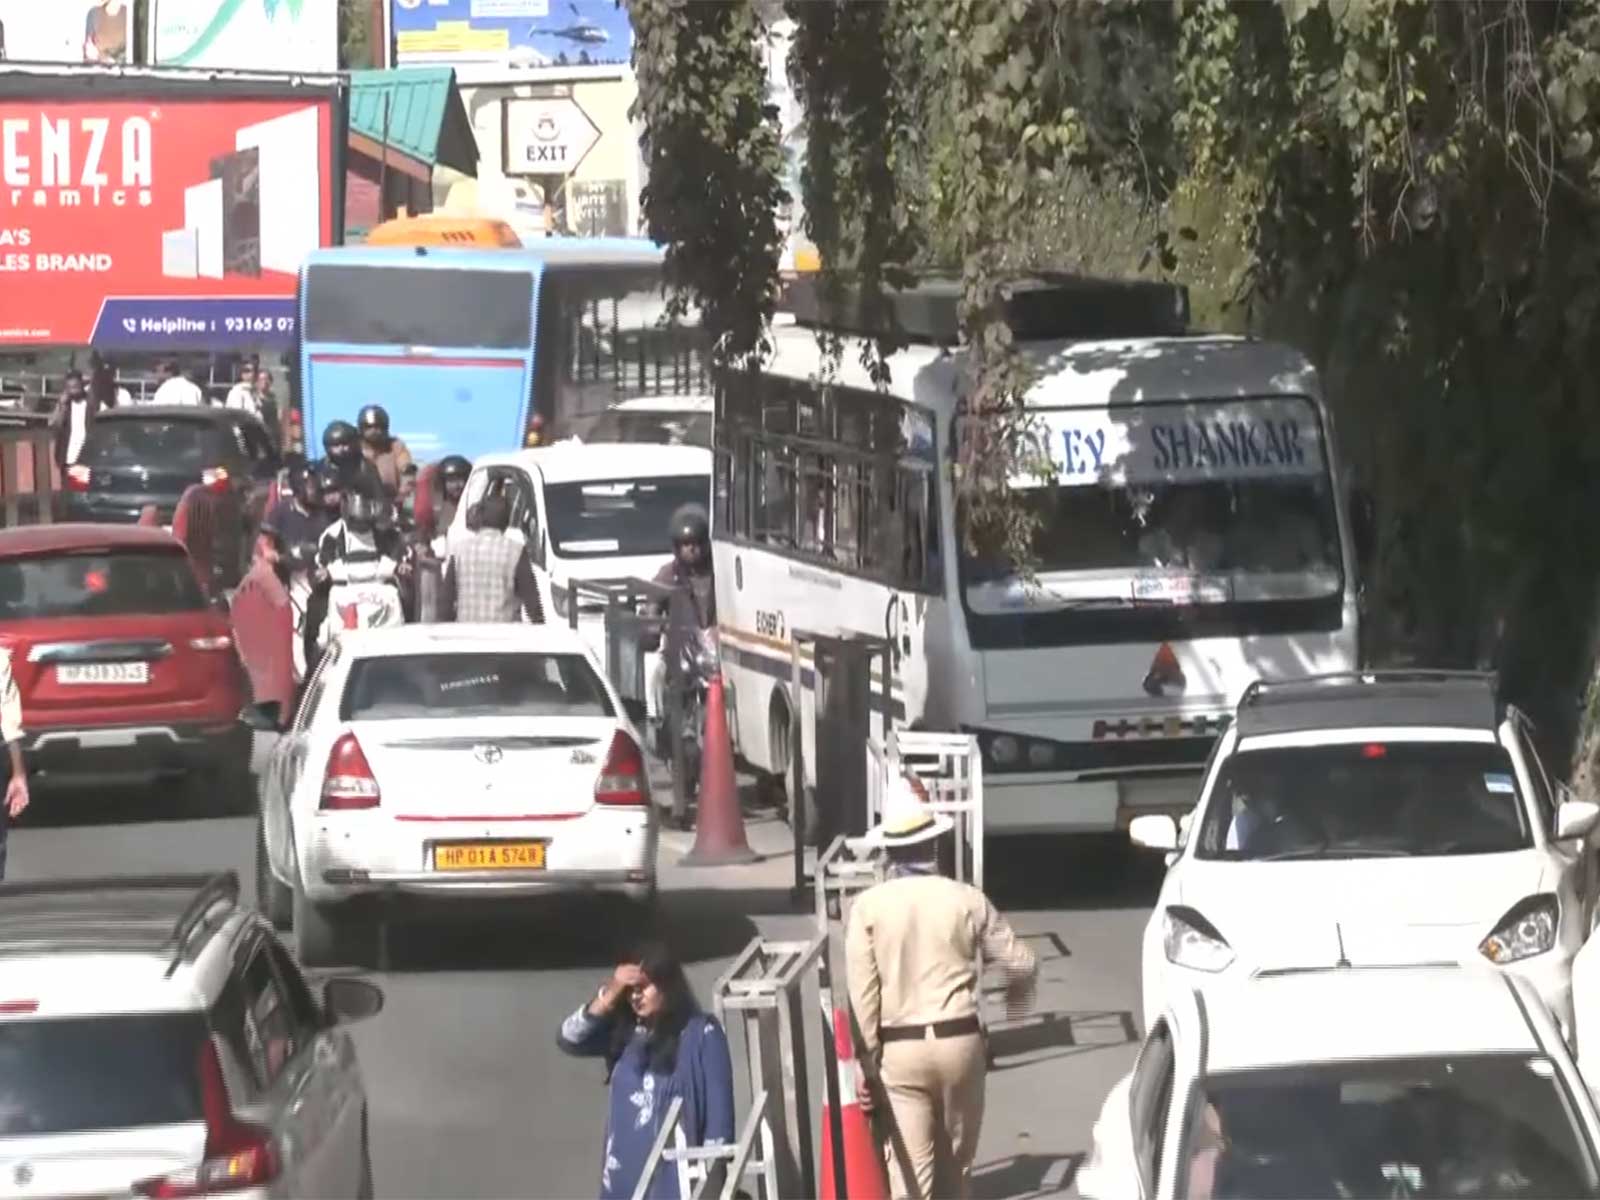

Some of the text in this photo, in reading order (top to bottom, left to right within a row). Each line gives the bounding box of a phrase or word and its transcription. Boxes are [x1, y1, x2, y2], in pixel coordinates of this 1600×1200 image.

[526, 145, 567, 162] EXIT
[36, 253, 112, 271] BRAND
[140, 317, 206, 334] Helpline
[225, 317, 272, 331] 93165
[1151, 418, 1304, 471] SHANKAR
